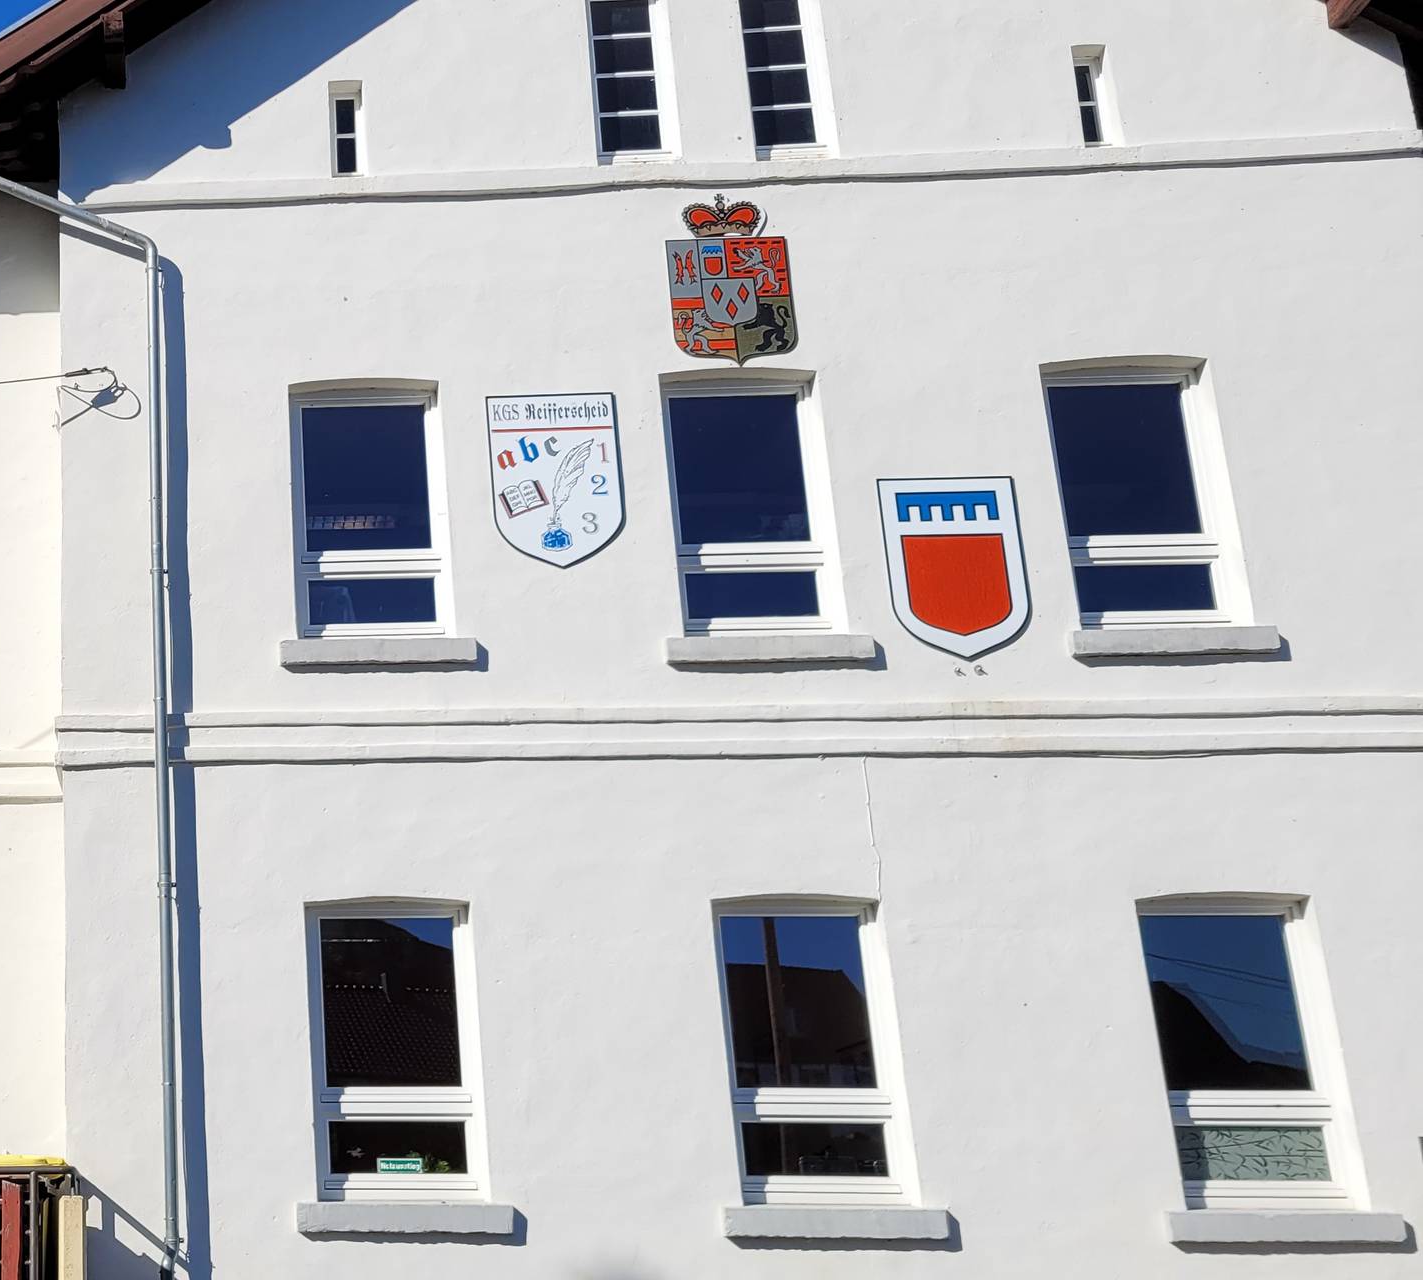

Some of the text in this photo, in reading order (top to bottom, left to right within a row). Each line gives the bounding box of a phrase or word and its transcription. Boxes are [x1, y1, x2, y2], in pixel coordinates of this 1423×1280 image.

[492, 401, 609, 424] KGS Reifferscheid
[597, 442, 610, 463] 1
[591, 474, 608, 495] 2
[582, 512, 598, 534] 3
